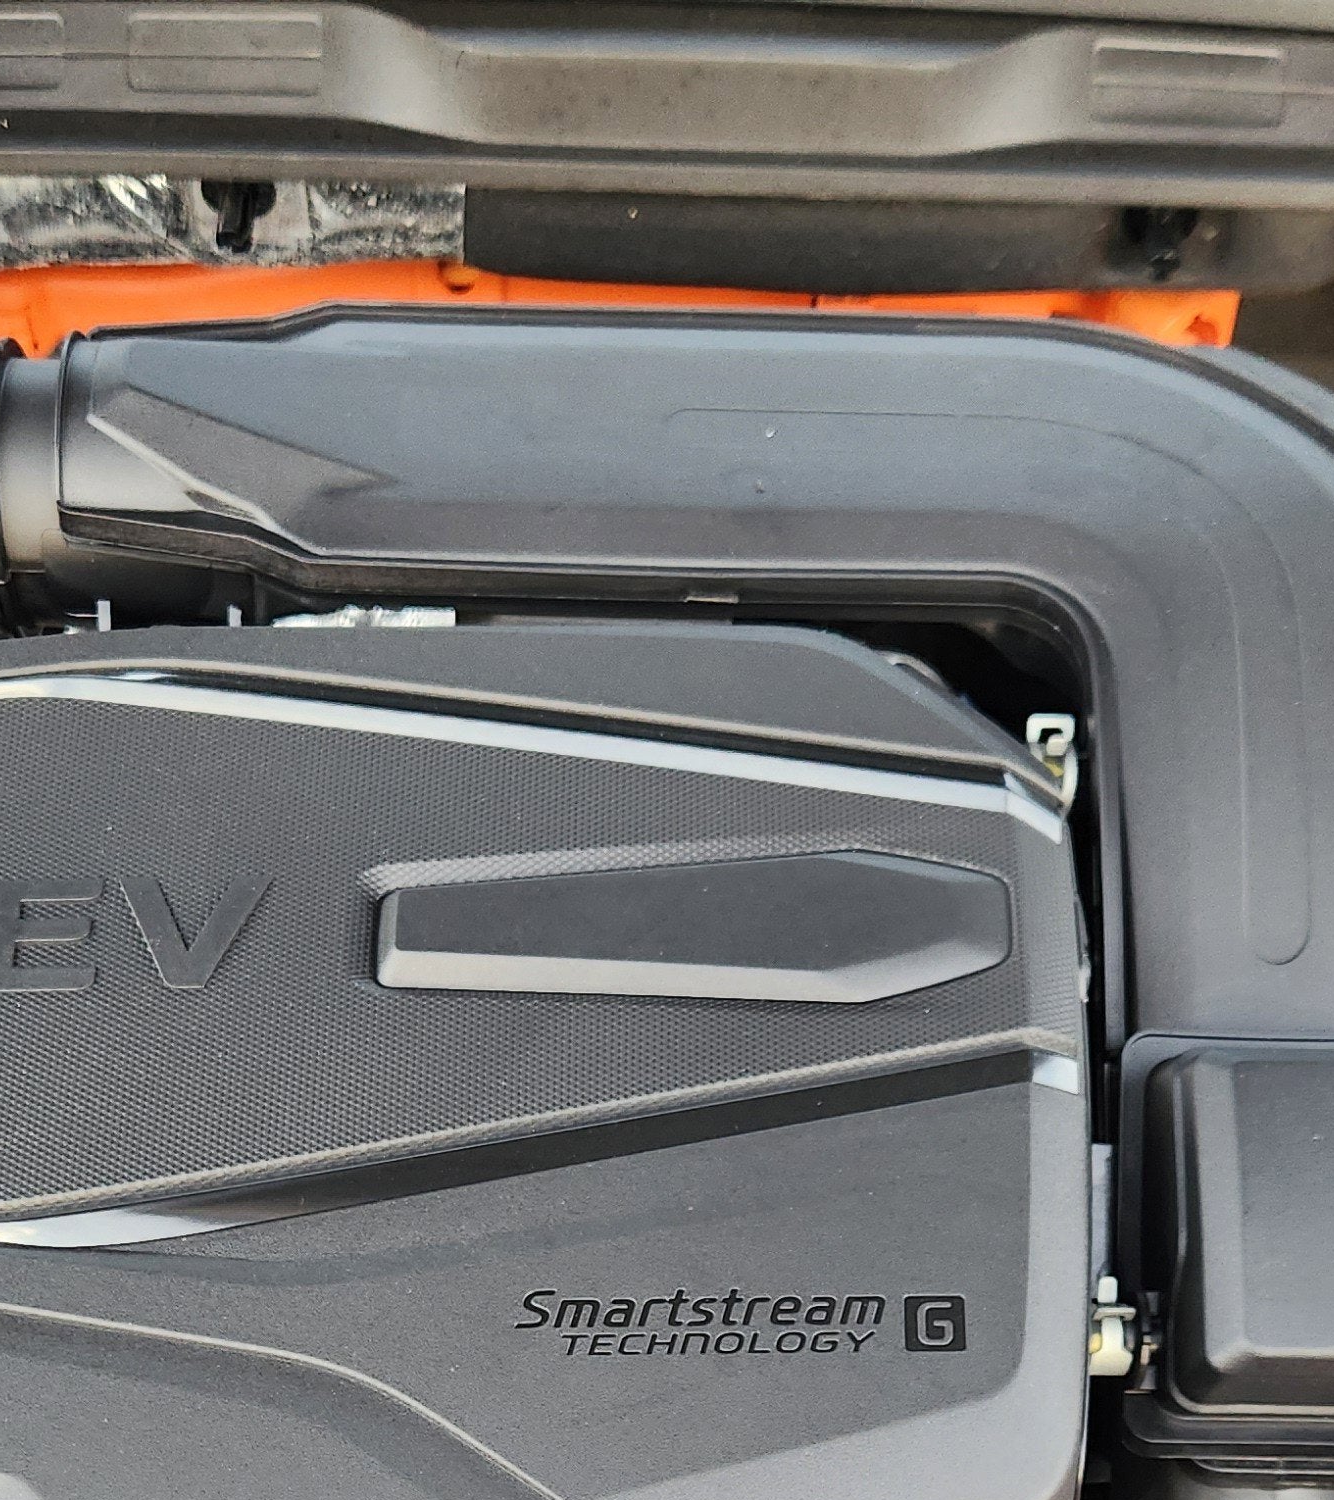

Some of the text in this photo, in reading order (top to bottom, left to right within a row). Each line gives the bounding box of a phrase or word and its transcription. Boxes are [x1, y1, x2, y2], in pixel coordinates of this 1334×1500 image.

[514, 1288, 887, 1329] Smartstream
[909, 1297, 961, 1350] G
[561, 1330, 875, 1357] TECHNOLOGY
